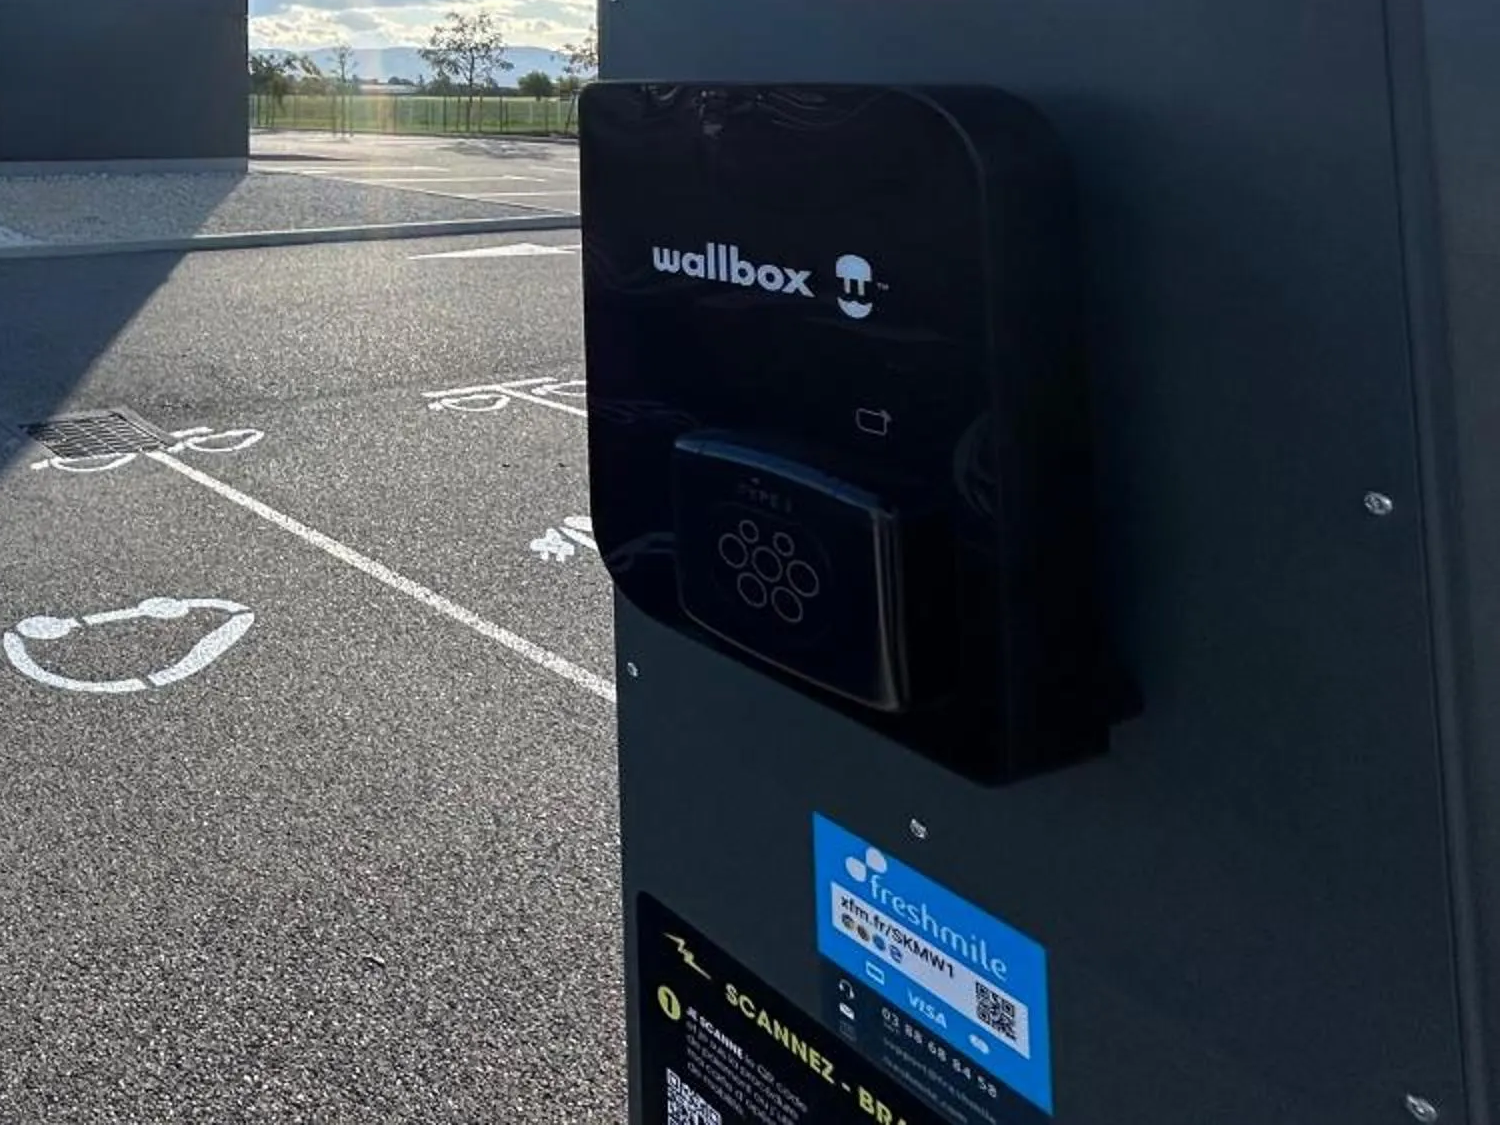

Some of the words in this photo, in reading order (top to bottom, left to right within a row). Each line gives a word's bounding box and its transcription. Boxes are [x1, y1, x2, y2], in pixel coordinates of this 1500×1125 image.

[653, 241, 815, 298] wallbox
[841, 895, 955, 978] xfm.fr/SKMW1
[871, 874, 1007, 981] freshmile
[881, 1007, 900, 1027] 03
[907, 986, 948, 1029] VISA
[700, 1016, 743, 1060] SCANNE
[725, 983, 835, 1084] SCANNEZ
[858, 1085, 907, 1125] BR
